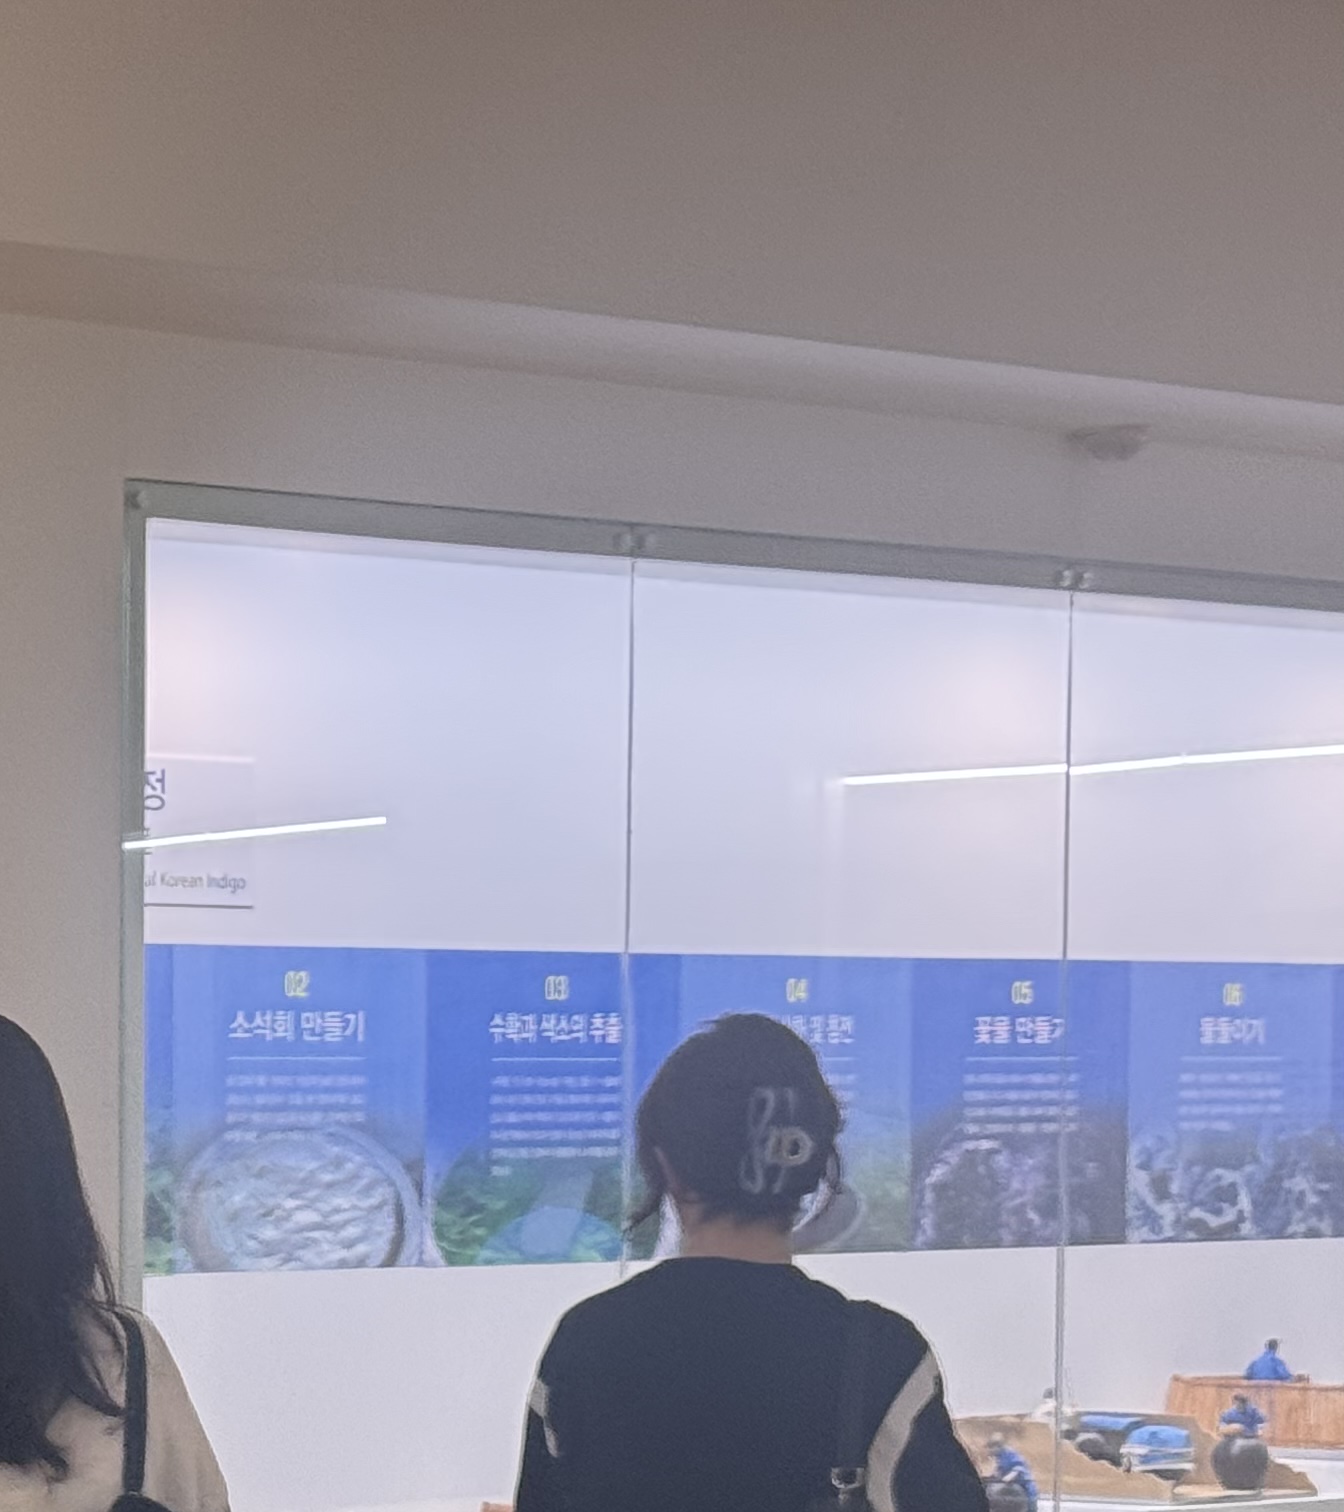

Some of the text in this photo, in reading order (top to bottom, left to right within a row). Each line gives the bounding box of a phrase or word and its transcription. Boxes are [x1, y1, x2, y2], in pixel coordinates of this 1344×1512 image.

[160, 872, 204, 888] Korean
[207, 872, 247, 894] Indigo
[283, 969, 311, 998] 02
[544, 974, 570, 1001] 03
[785, 977, 810, 1003] 04
[1010, 979, 1034, 1005] 05
[1221, 981, 1245, 1007] 06
[227, 1009, 367, 1042] 소석회 만들기
[1015, 1015, 1066, 1045] 만들기
[1199, 1015, 1267, 1046] 물들이기
